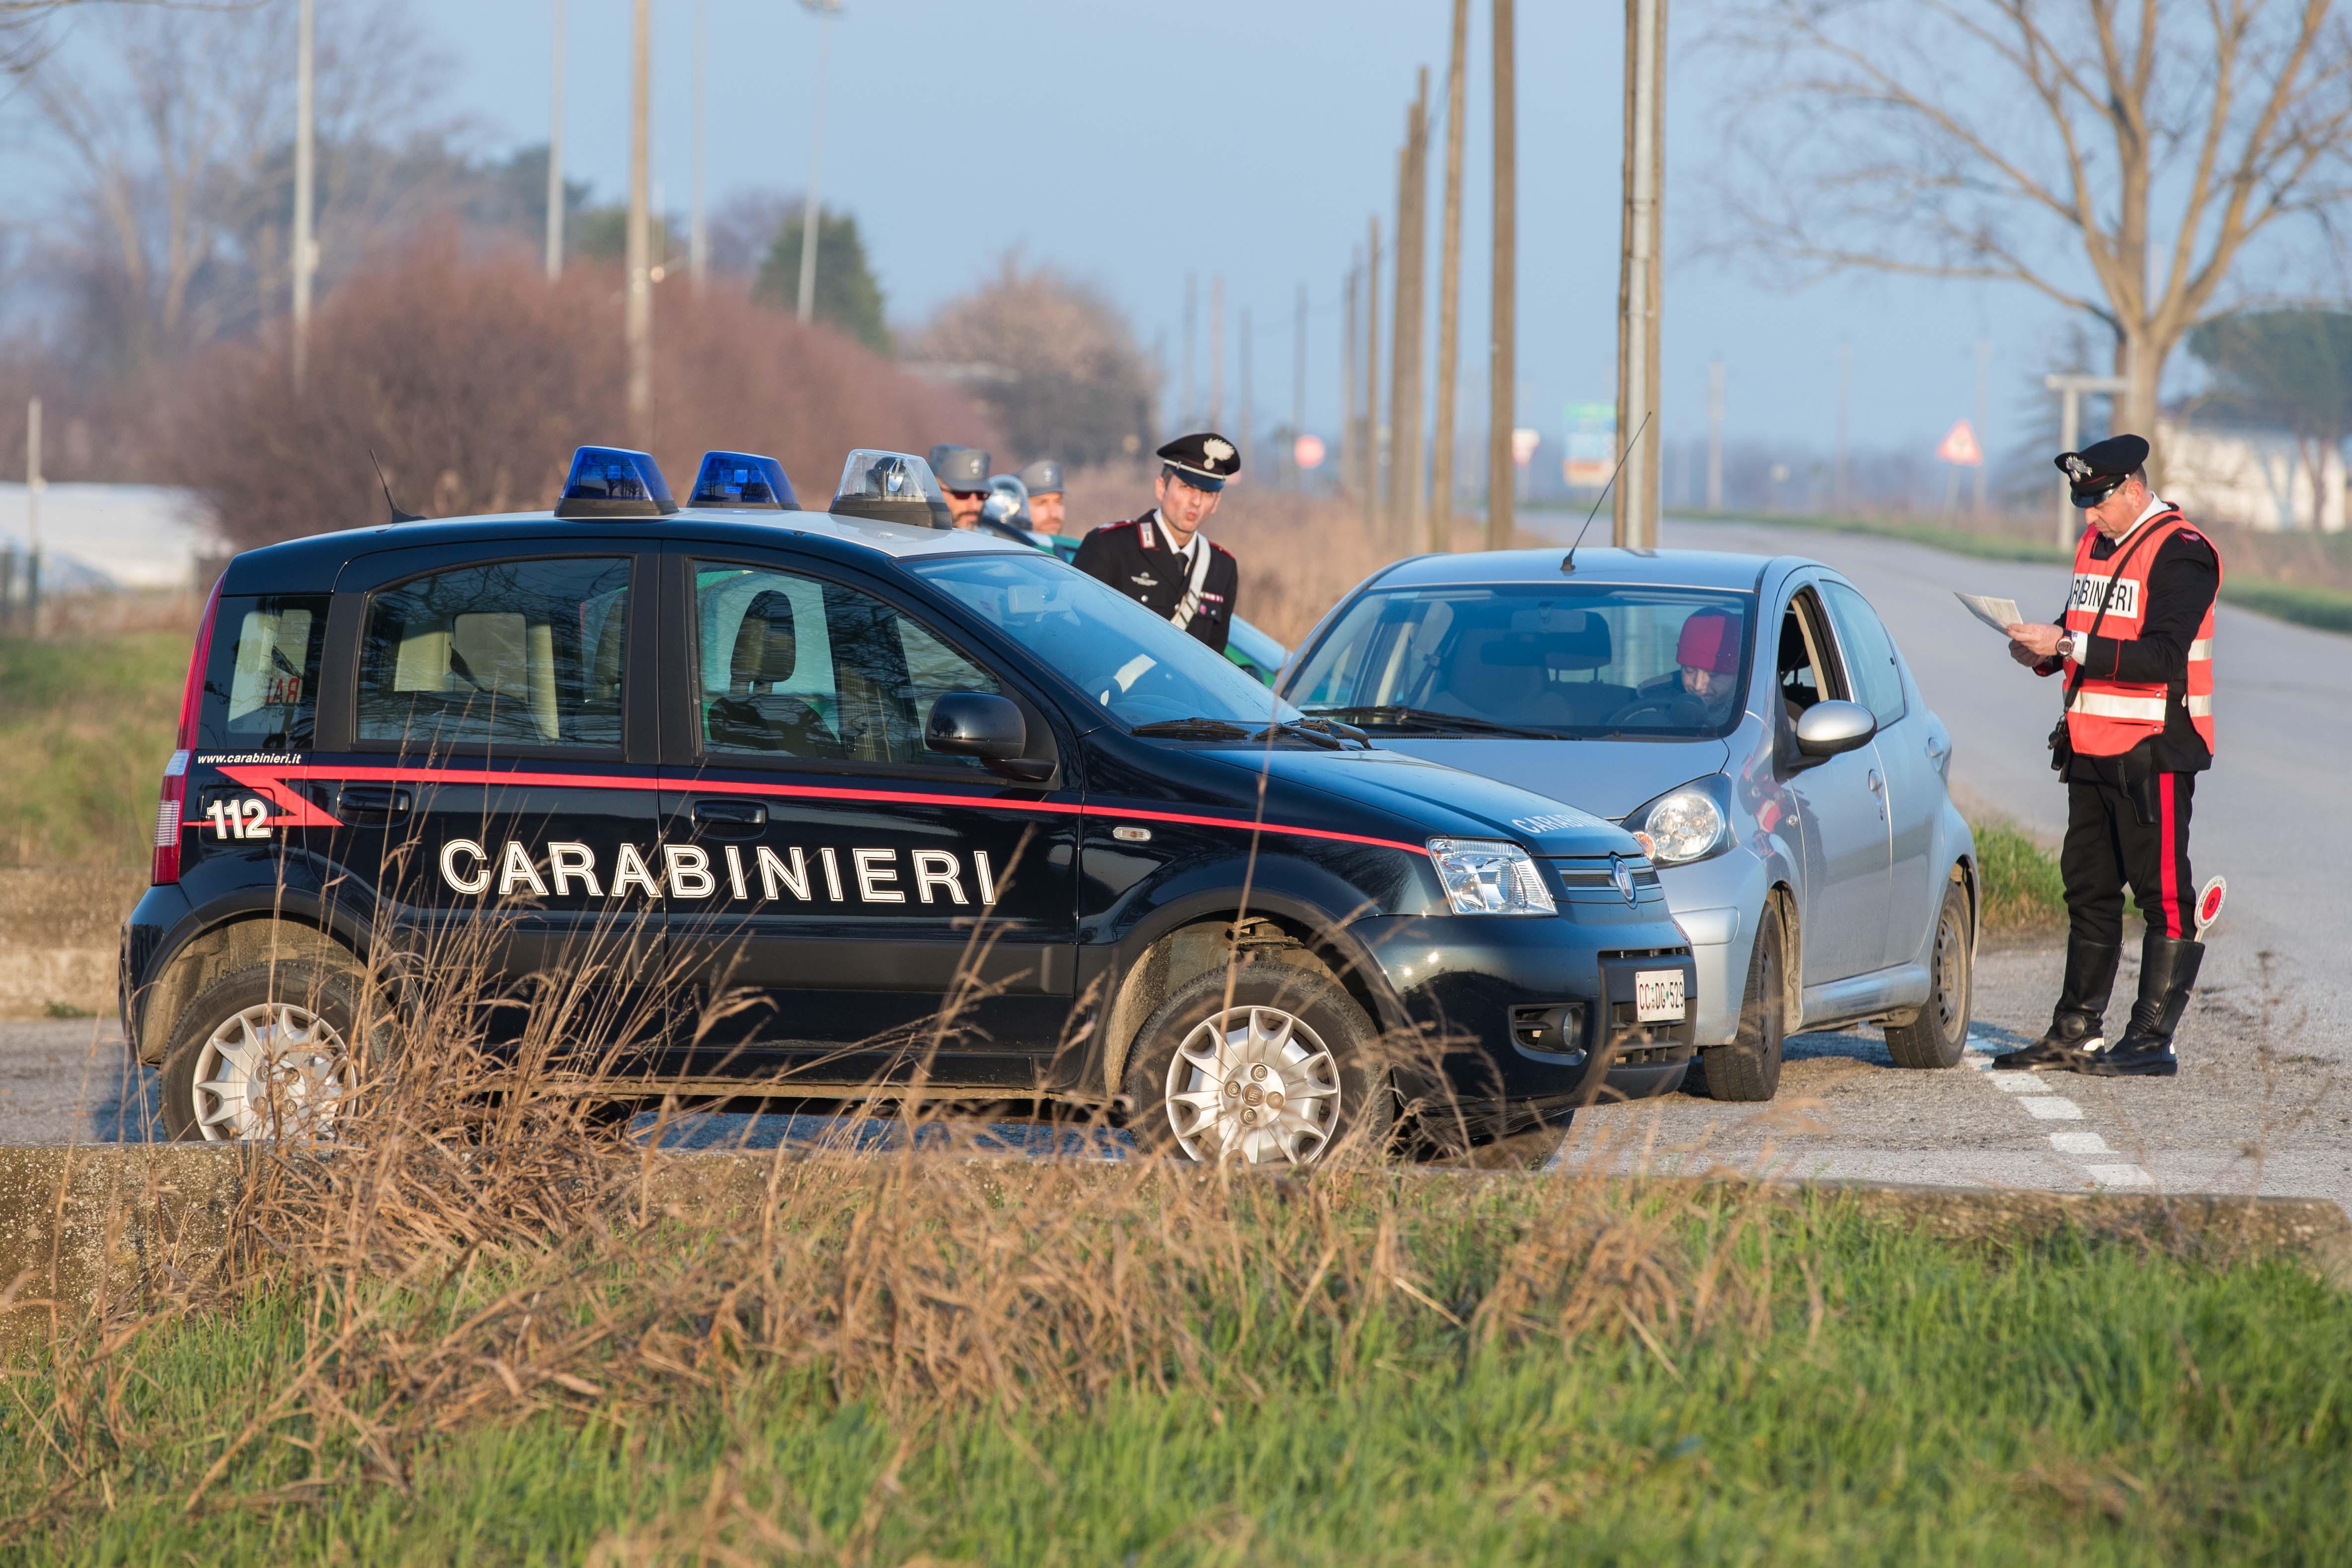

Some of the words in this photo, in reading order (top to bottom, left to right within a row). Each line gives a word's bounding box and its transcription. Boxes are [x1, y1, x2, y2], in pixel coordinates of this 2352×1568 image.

[198, 752, 301, 764] www.carabinieri.it
[207, 799, 272, 839] 112
[440, 838, 996, 905] CARABINIERI
[1639, 983, 1651, 1010] CC
[1655, 982, 1665, 1010] DG
[1669, 981, 1684, 1009] 529
